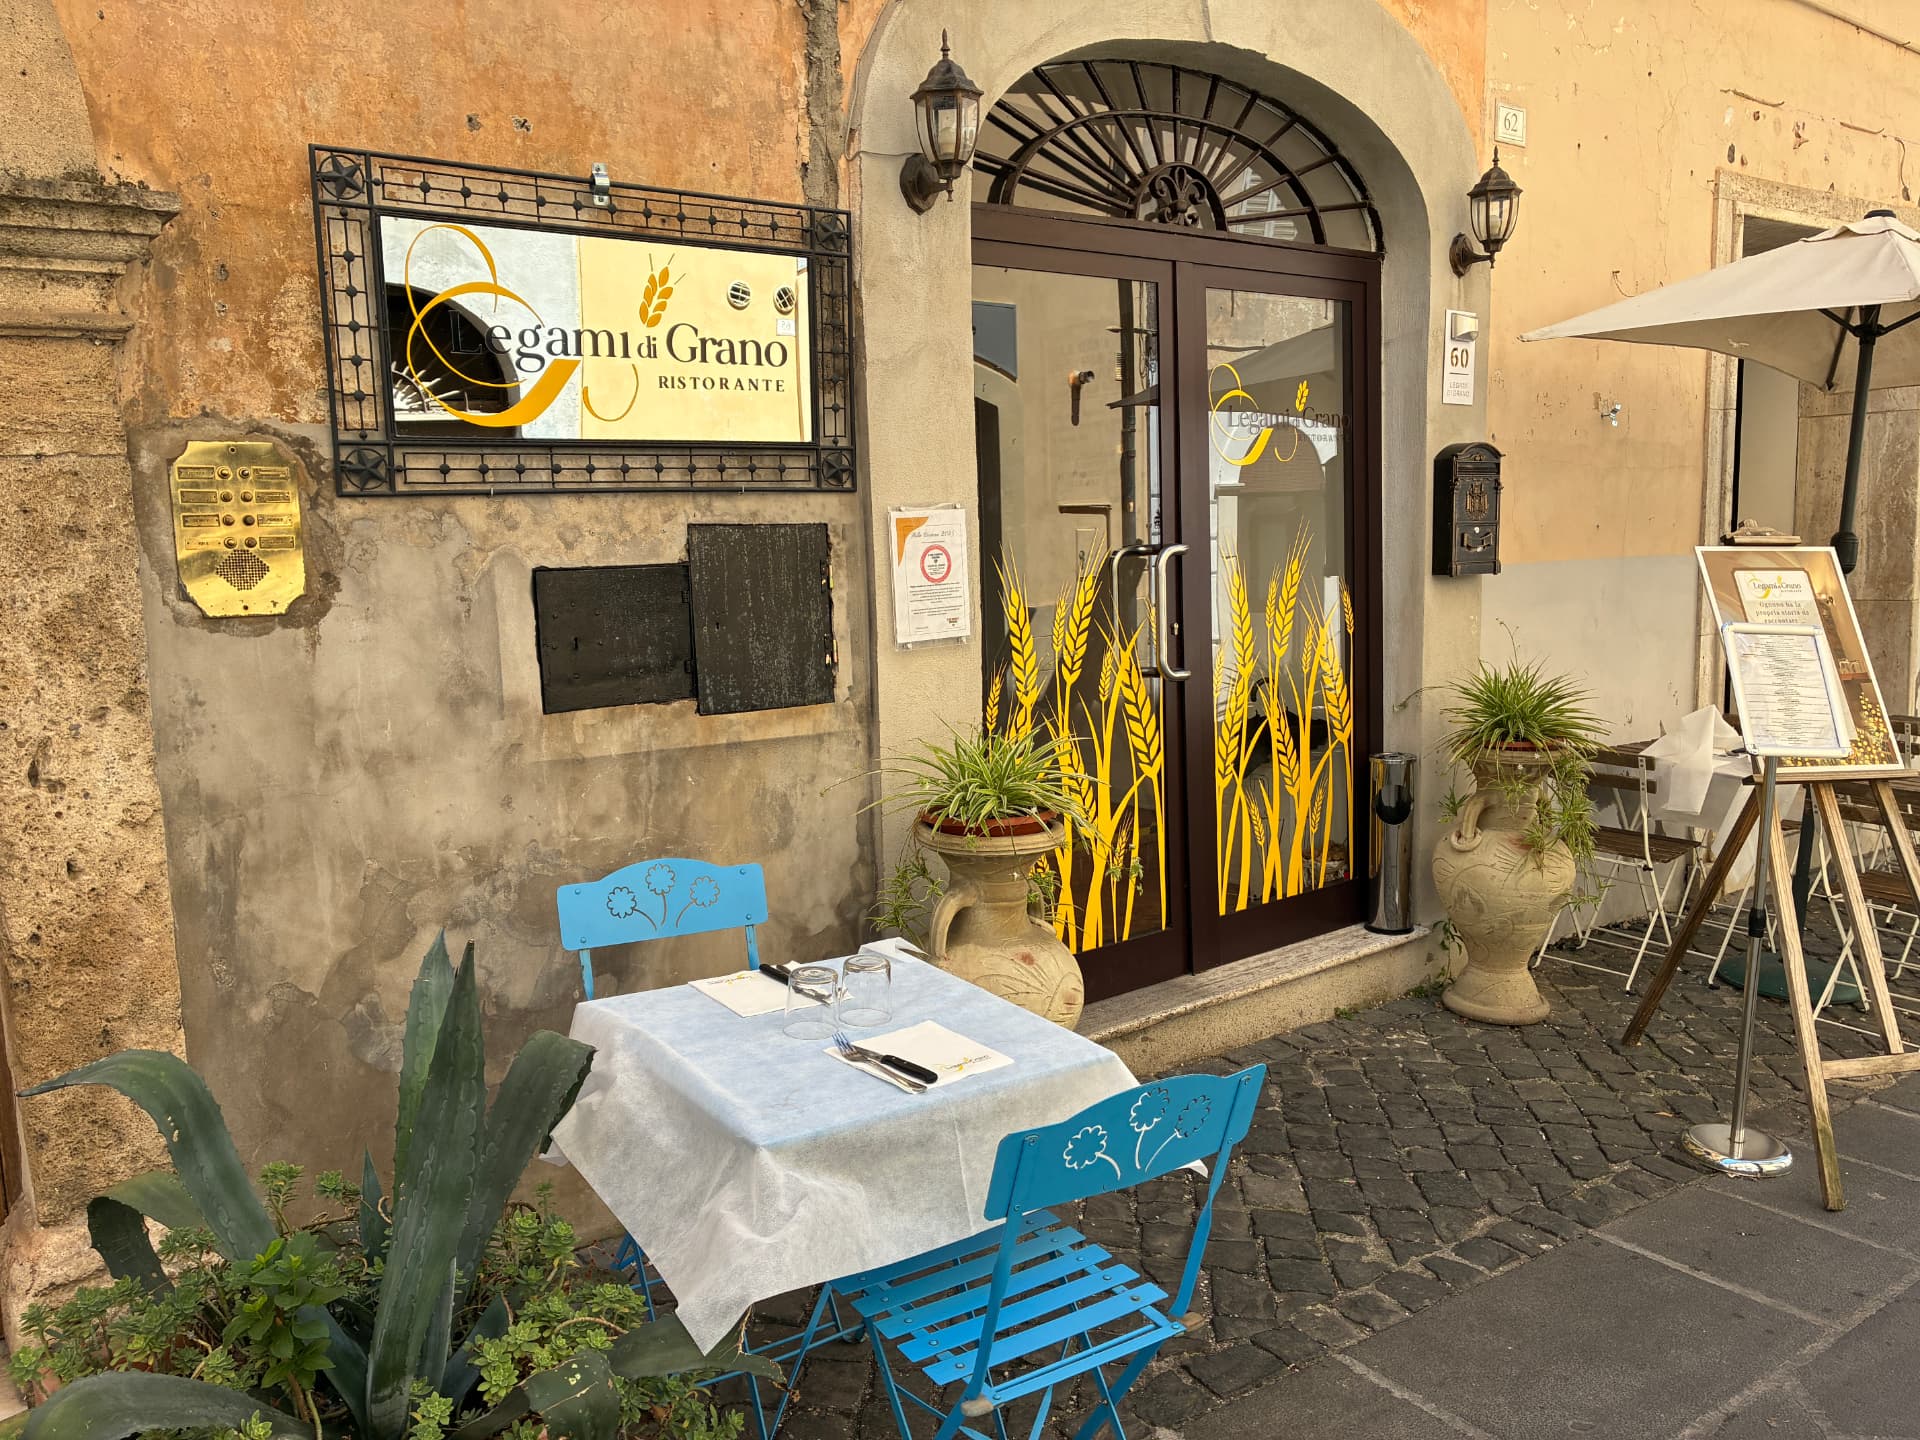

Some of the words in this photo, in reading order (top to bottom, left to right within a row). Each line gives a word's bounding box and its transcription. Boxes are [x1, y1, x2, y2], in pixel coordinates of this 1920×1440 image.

[1503, 112, 1518, 132] 62
[449, 309, 632, 373] Legami
[637, 335, 657, 359] di
[666, 322, 788, 368] Grano
[1450, 347, 1469, 368] 60
[658, 375, 785, 393] RISTORANTE
[1228, 405, 1290, 435] Legami
[1302, 406, 1351, 429] Grano
